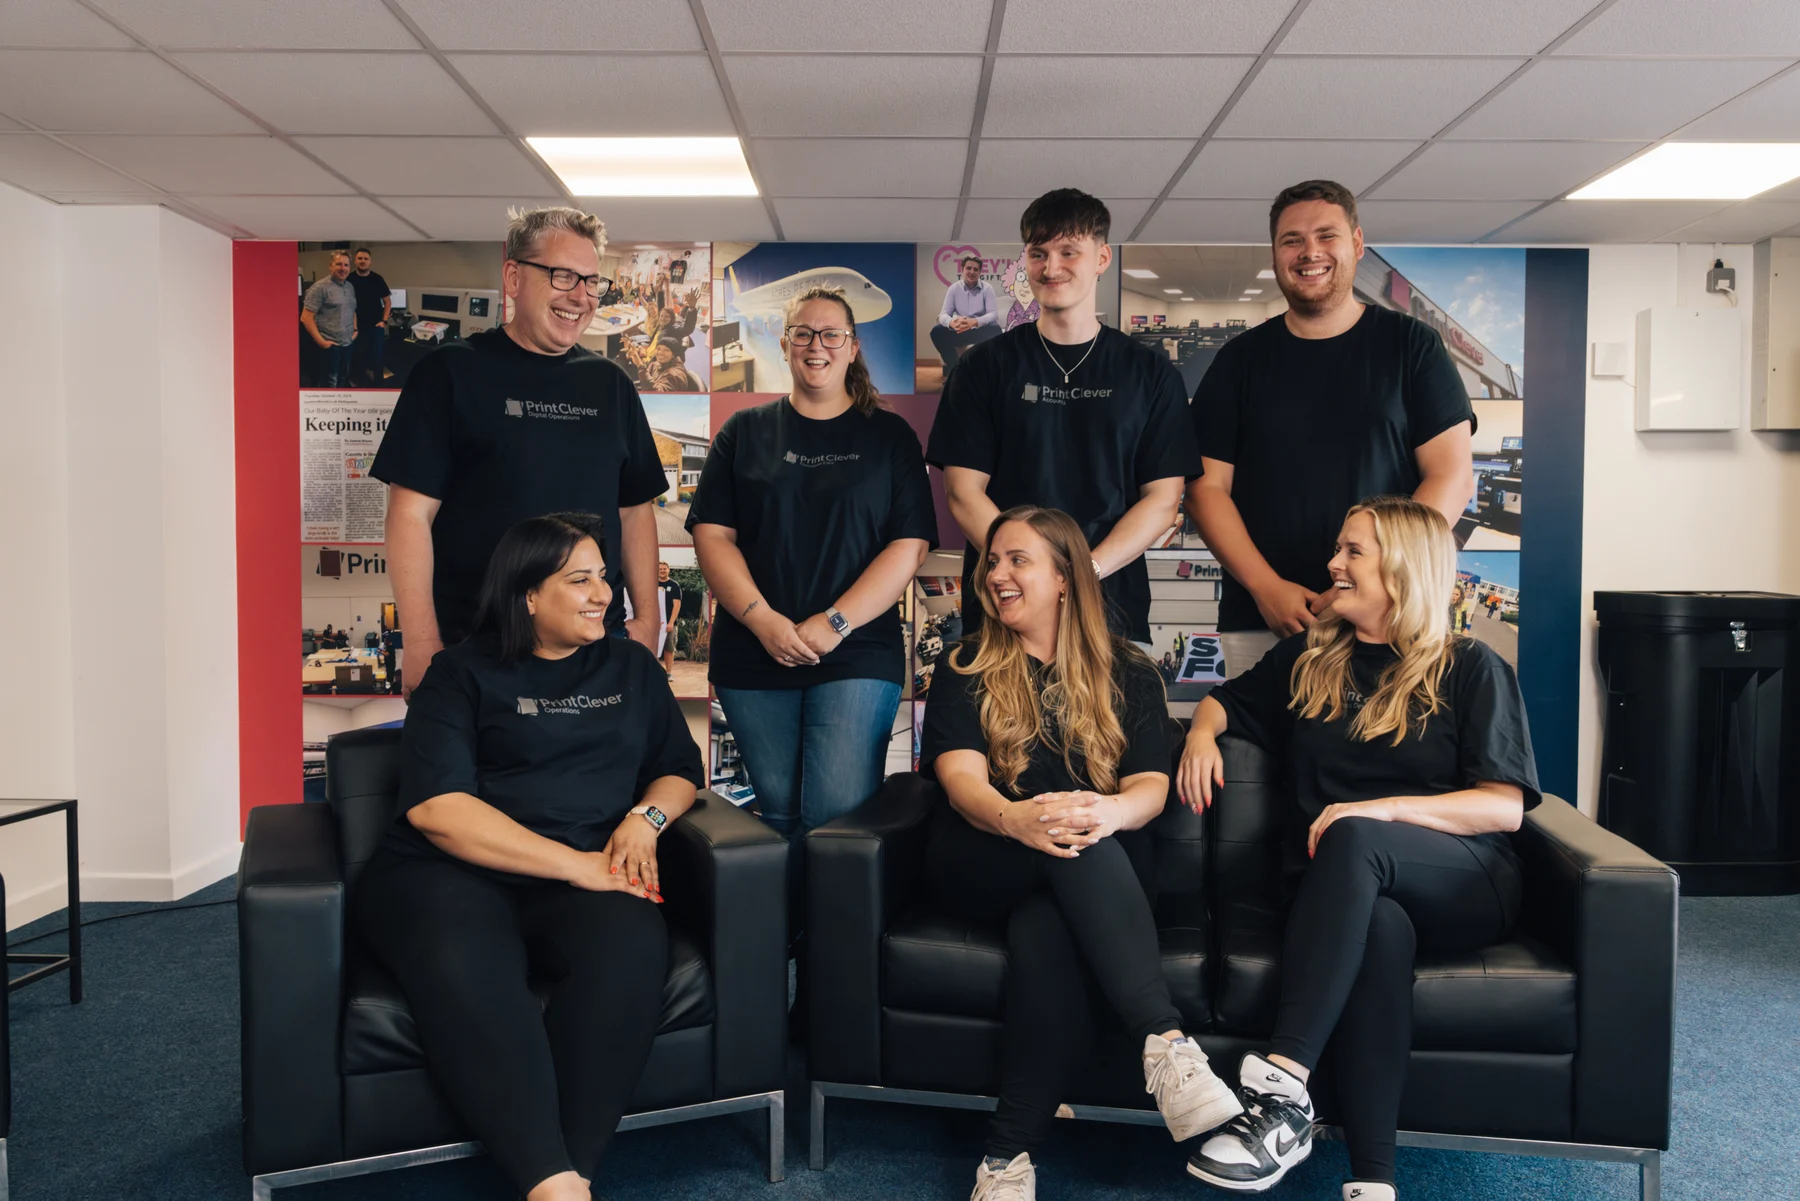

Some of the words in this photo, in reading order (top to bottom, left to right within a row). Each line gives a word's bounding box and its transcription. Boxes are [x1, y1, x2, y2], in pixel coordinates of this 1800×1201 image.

[1042, 385, 1112, 400] PrintClever
[526, 401, 598, 416] PrintClever
[305, 417, 372, 435] Keeping
[376, 417, 388, 433] it
[800, 454, 860, 464] PrintClever
[540, 694, 622, 708] PrintClever
